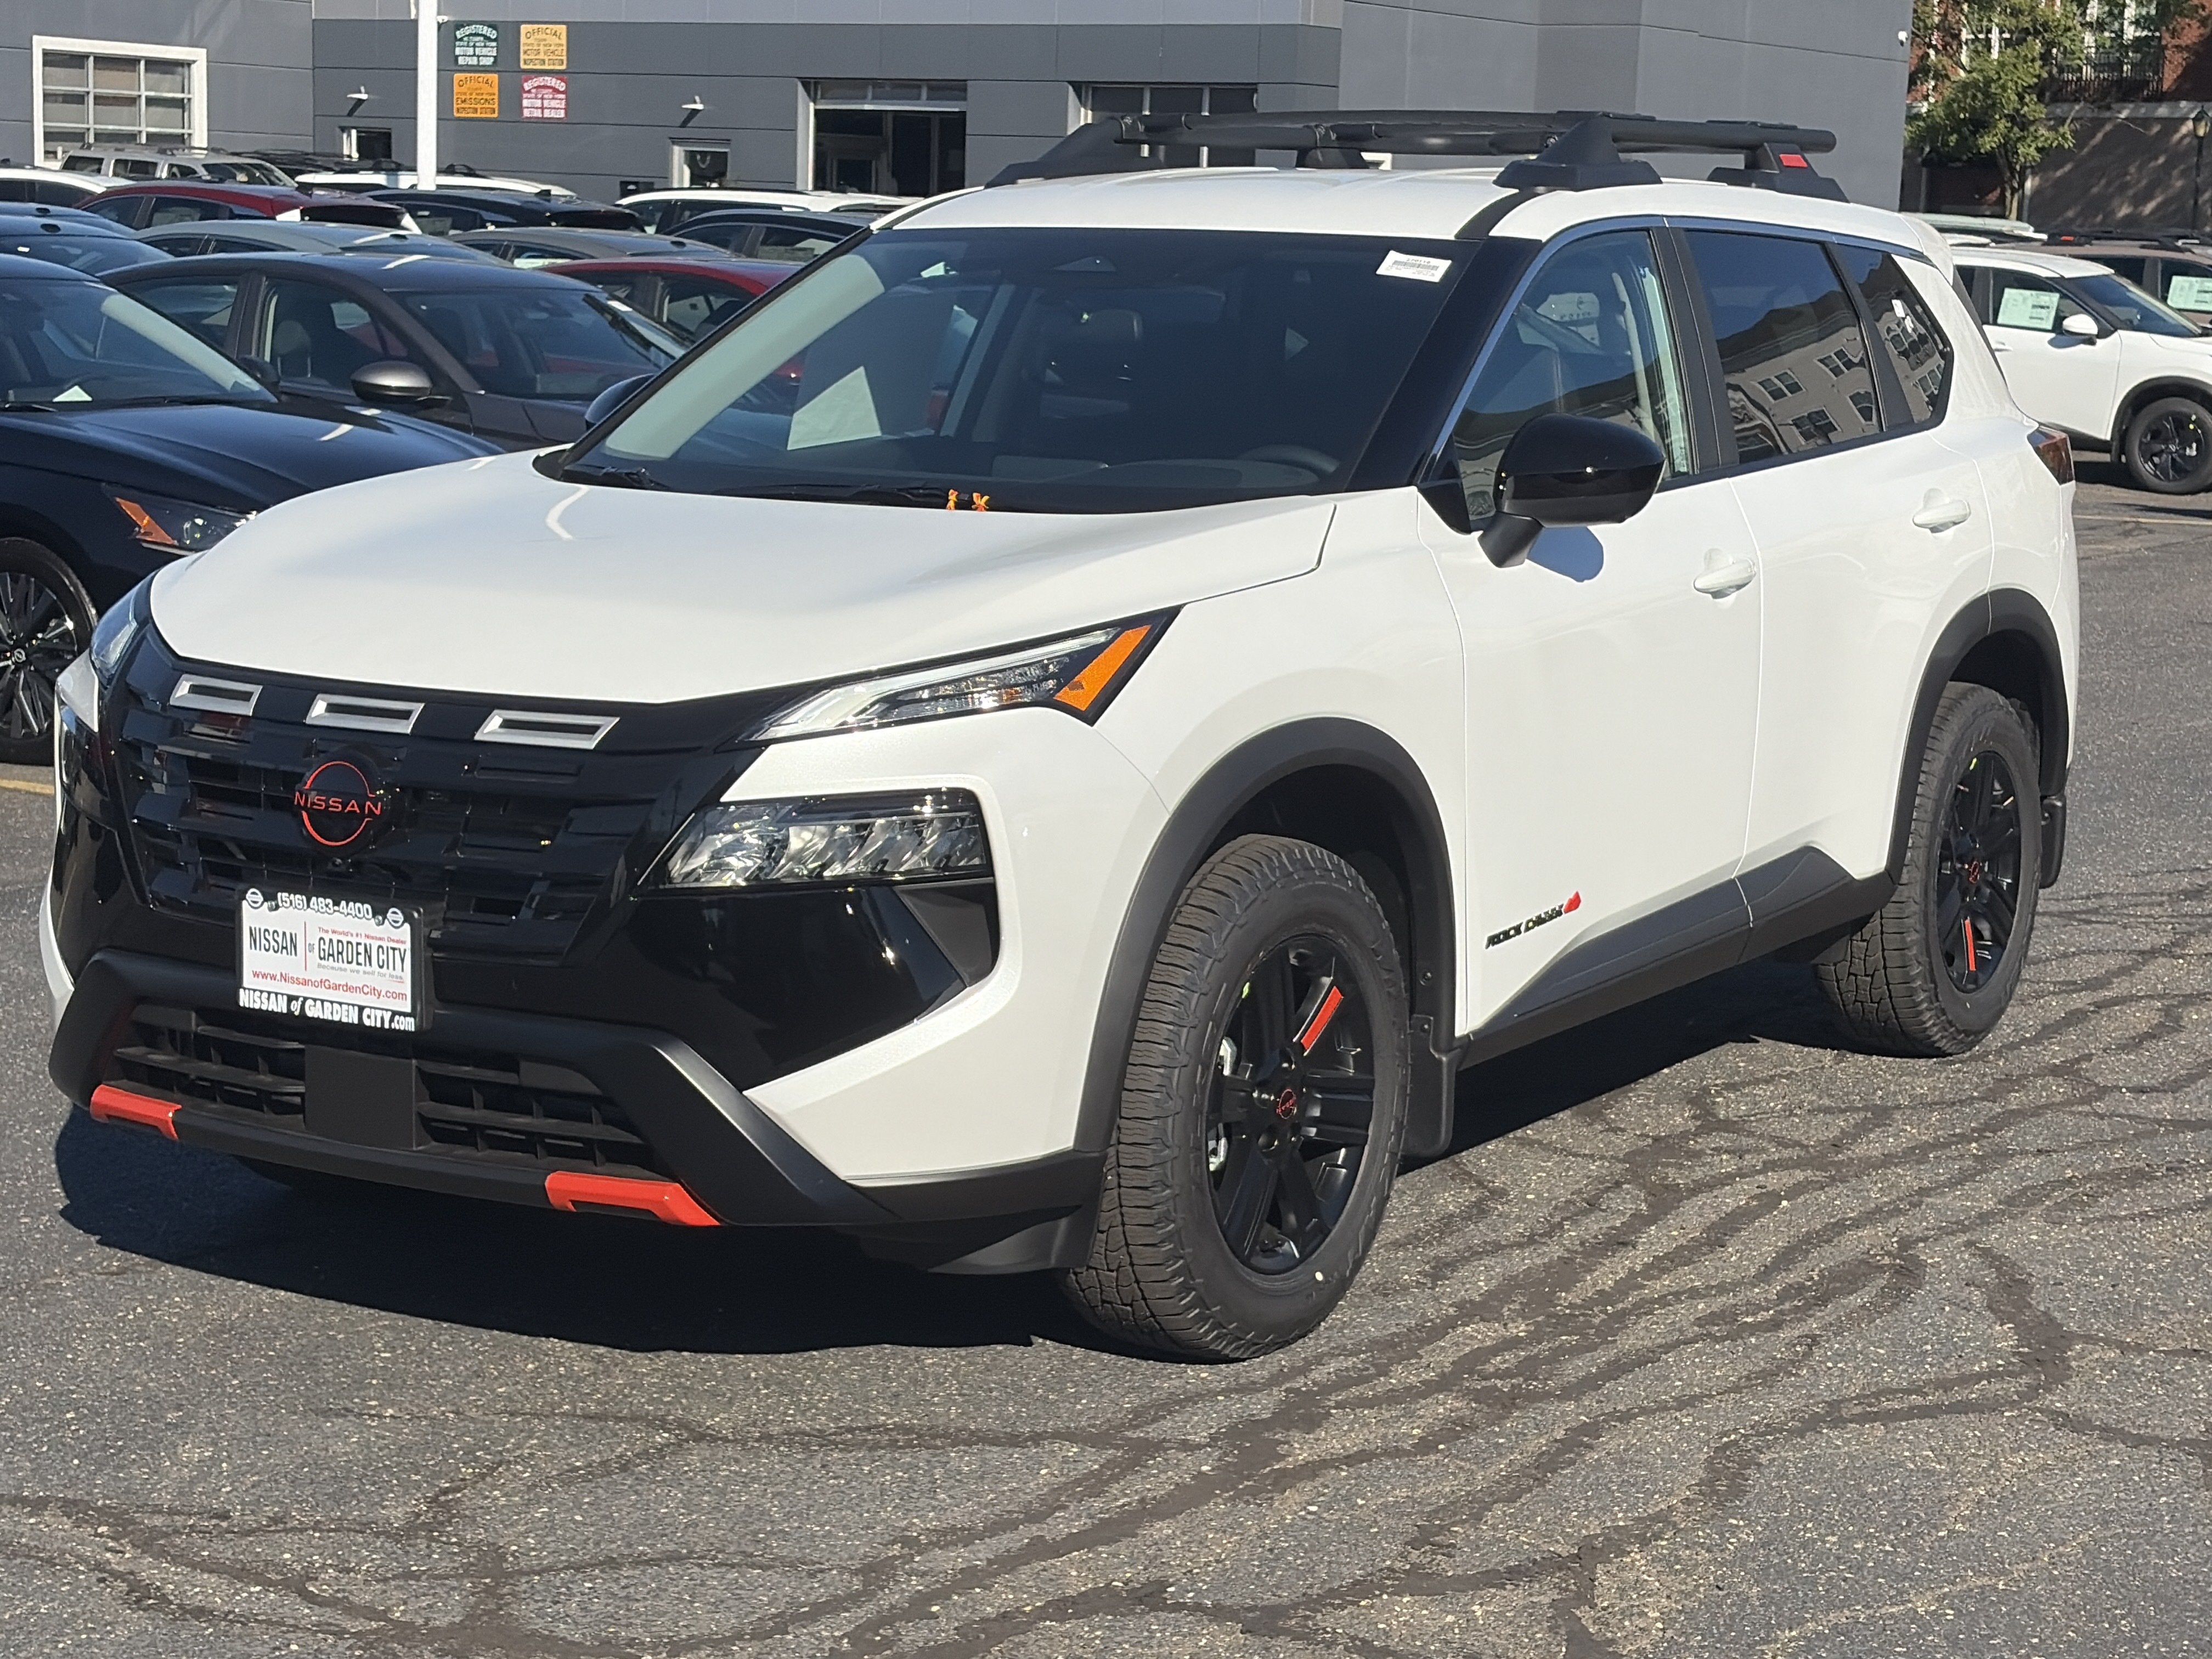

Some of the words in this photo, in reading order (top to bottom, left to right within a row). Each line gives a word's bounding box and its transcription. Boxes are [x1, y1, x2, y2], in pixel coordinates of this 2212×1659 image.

[455, 25, 498, 39] REGISTERED
[525, 27, 562, 40] OFFICIAL
[455, 47, 474, 55] MOTOR
[475, 47, 497, 56] VEHICLE
[523, 48, 540, 57] MOTOR
[543, 49, 565, 57] VEHICLE
[458, 56, 478, 65] REPAIR
[479, 57, 494, 65] SHOP
[458, 76, 493, 88] OFFICIAL
[523, 76, 566, 91] REGISTERED
[456, 97, 495, 105] EMISSIONS
[522, 99, 542, 108] MOTOR
[543, 99, 566, 108] VEHICLE
[456, 106, 478, 115] INSPECTION
[479, 106, 495, 115] STATION
[294, 791, 382, 815] NISSAN
[277, 891, 307, 912] (516)
[309, 896, 373, 919] 483-4400
[1485, 921, 1523, 950] ROCK
[1523, 902, 1564, 933] CREEK
[330, 928, 354, 938] World's
[364, 933, 386, 942] Nissan
[387, 936, 407, 945] Dealer
[249, 926, 298, 957] NISSAN
[308, 943, 315, 954] OF
[318, 936, 373, 968] GARDEN
[376, 944, 407, 973] CITY
[317, 963, 348, 973] Because
[362, 968, 375, 977] sell
[377, 970, 387, 979] for
[252, 970, 408, 1002] www.NissanofGardenCity.com
[239, 988, 288, 1014] NISSAN
[290, 997, 304, 1017] of
[304, 998, 359, 1024] GARDEN
[362, 1007, 416, 1032] CITY.com
